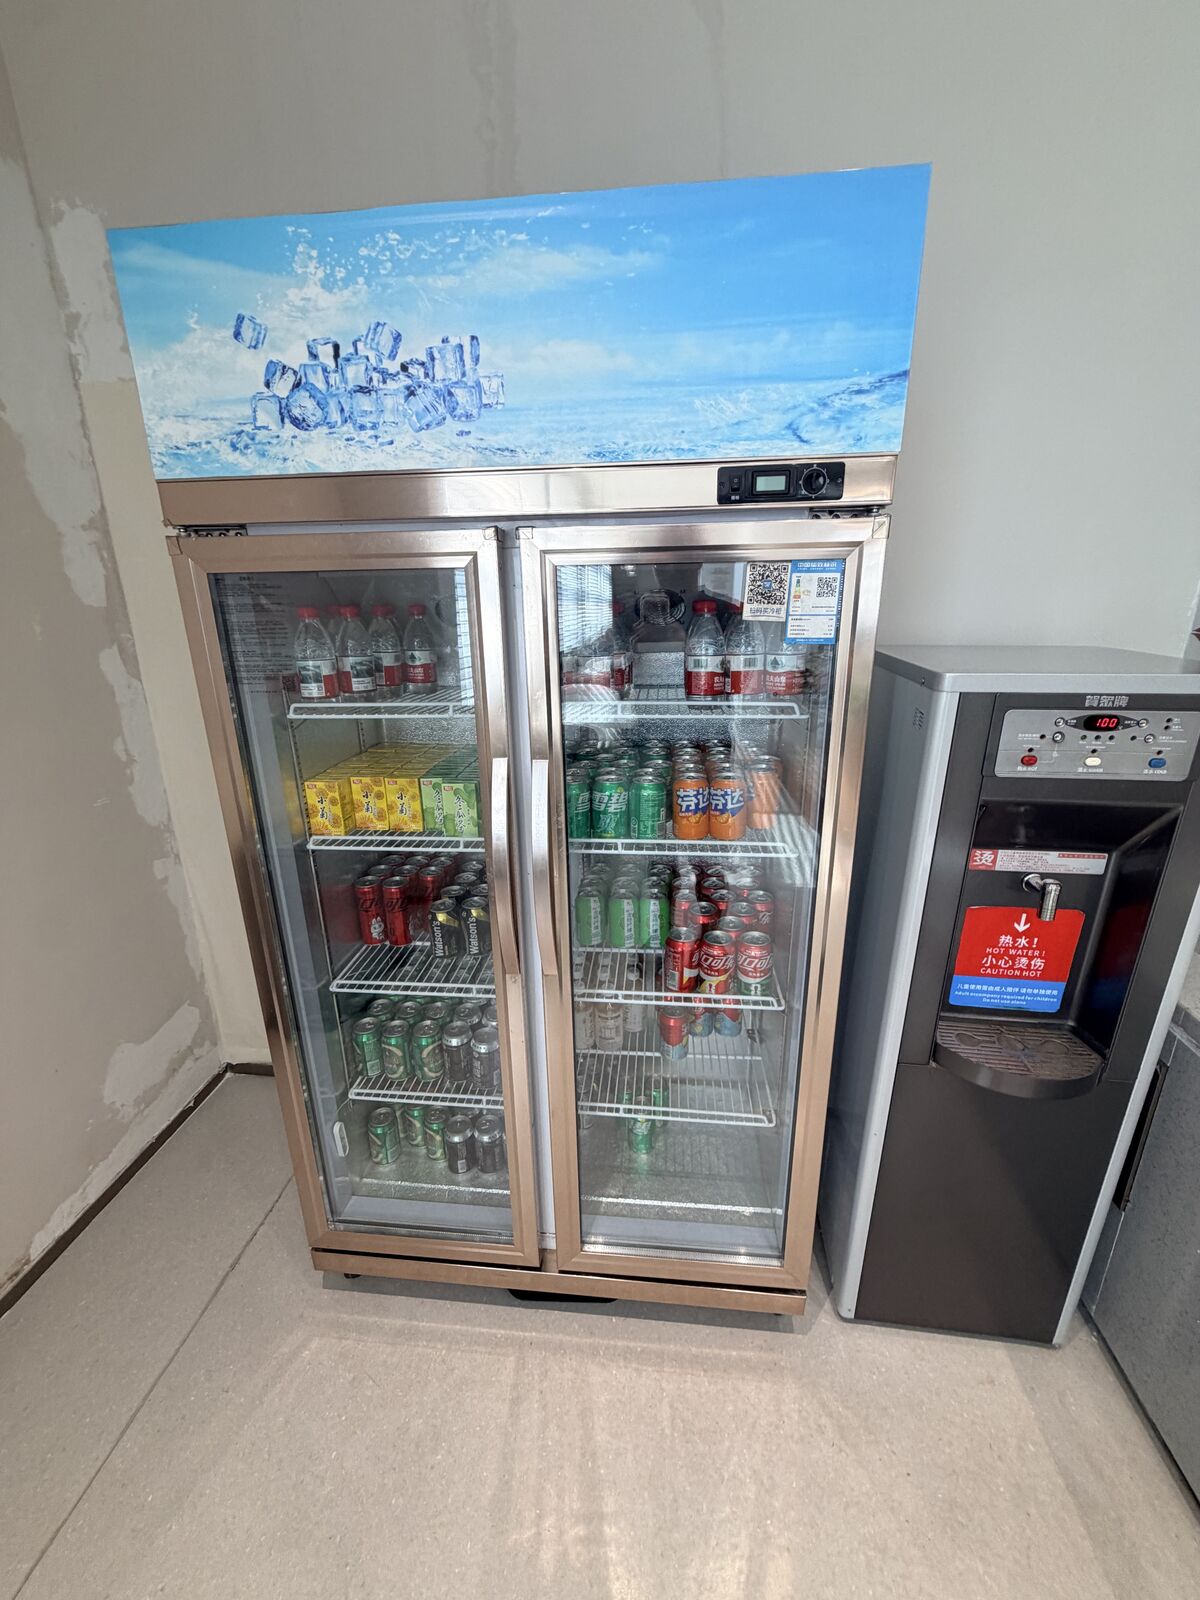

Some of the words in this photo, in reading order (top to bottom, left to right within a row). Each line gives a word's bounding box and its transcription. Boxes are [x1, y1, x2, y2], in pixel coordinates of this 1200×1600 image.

[1096, 717, 1118, 728] 100
[592, 790, 629, 813] 雪碧
[710, 787, 745, 810] 芬达
[973, 850, 995, 866] 烫
[432, 920, 445, 957] Watson's
[467, 916, 480, 954] Watson's
[980, 967, 1021, 976] CAUTION
[982, 955, 1045, 970] 小心烫伤
